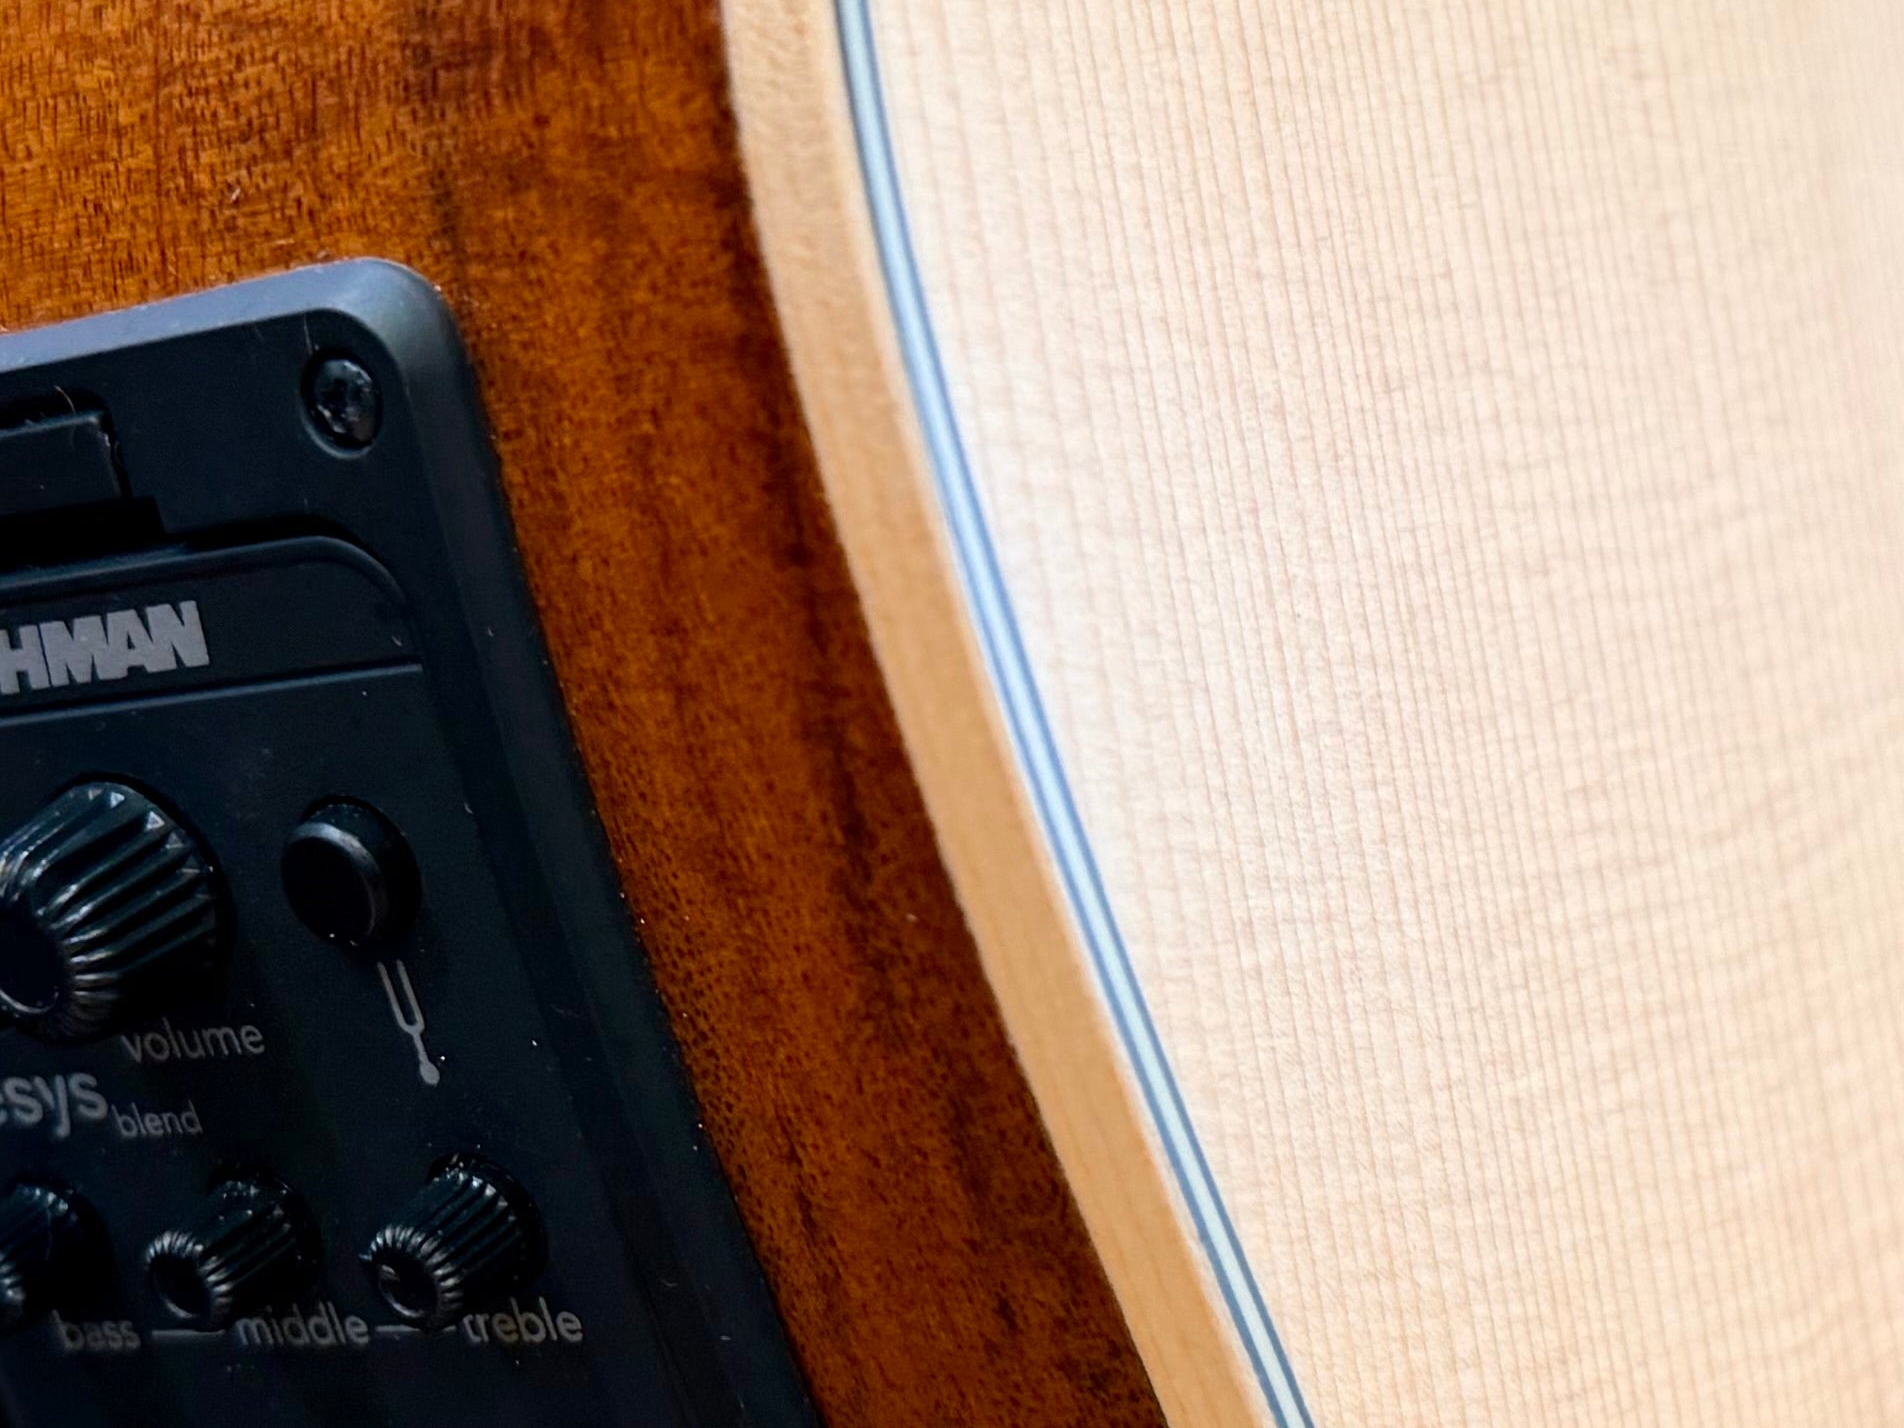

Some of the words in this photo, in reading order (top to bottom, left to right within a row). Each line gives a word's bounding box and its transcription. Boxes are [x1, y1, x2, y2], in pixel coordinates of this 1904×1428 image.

[121, 1017, 266, 1064] volume
[111, 1100, 203, 1139] blend
[51, 1310, 142, 1351] bass
[236, 1301, 370, 1347] middle
[462, 1296, 584, 1344] treble
